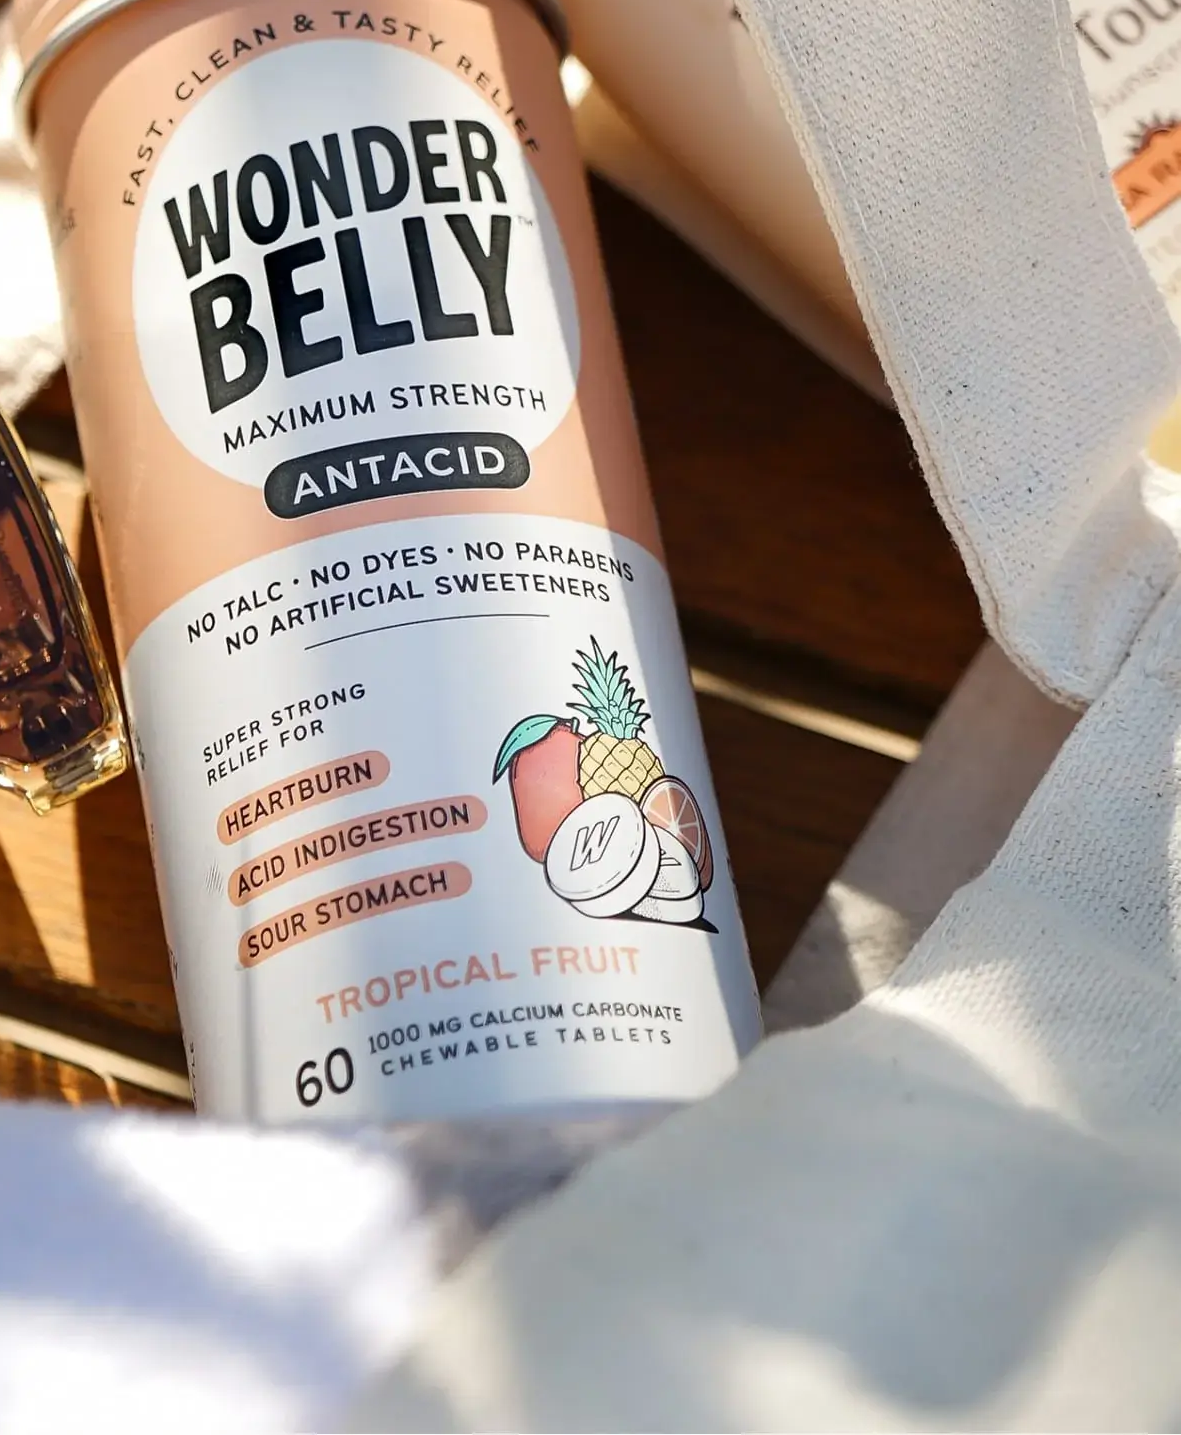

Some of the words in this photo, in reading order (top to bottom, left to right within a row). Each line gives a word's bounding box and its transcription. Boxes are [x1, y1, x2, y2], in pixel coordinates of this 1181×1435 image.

[123, 118, 173, 207] FAST,
[175, 24, 276, 101] CLEAN
[293, 14, 315, 33] &
[332, 10, 446, 53] TASTY
[456, 55, 540, 153] RELIEF
[163, 119, 507, 278] WONDER
[190, 213, 514, 414] BELLY
[223, 391, 376, 454] MAXIMUM
[390, 383, 547, 413] STRENGTH
[293, 444, 505, 505] ANTACID
[186, 612, 217, 645] NO
[222, 580, 284, 622] TALC
[310, 560, 351, 589] NO
[362, 545, 438, 576] DYES
[464, 541, 505, 563] NO
[515, 542, 635, 583] PARABENS
[225, 626, 260, 656] NO
[269, 580, 425, 637] ARTIFICIAL
[434, 573, 611, 603] SWEETENERS
[202, 719, 263, 765] SUPER
[270, 683, 367, 727] STRONG
[205, 739, 270, 787] RELIEF
[278, 719, 325, 750] FOR
[224, 758, 373, 837] HEARTBURN
[237, 854, 286, 899] ACID
[293, 802, 471, 869] INDIGESTION
[569, 815, 621, 872] W
[246, 912, 308, 959] SOUR
[315, 869, 449, 926] STOMACH
[315, 952, 517, 1024] TROPICAL
[530, 945, 641, 977] FRUIT
[294, 1046, 355, 1108] 60
[368, 1022, 421, 1055] 1000
[428, 1016, 463, 1038] MG
[470, 1002, 565, 1030] CALCIUM
[571, 1001, 683, 1022] CARBONATE
[380, 1030, 539, 1077] CHEWABLE
[555, 1026, 672, 1045] TABLETS
